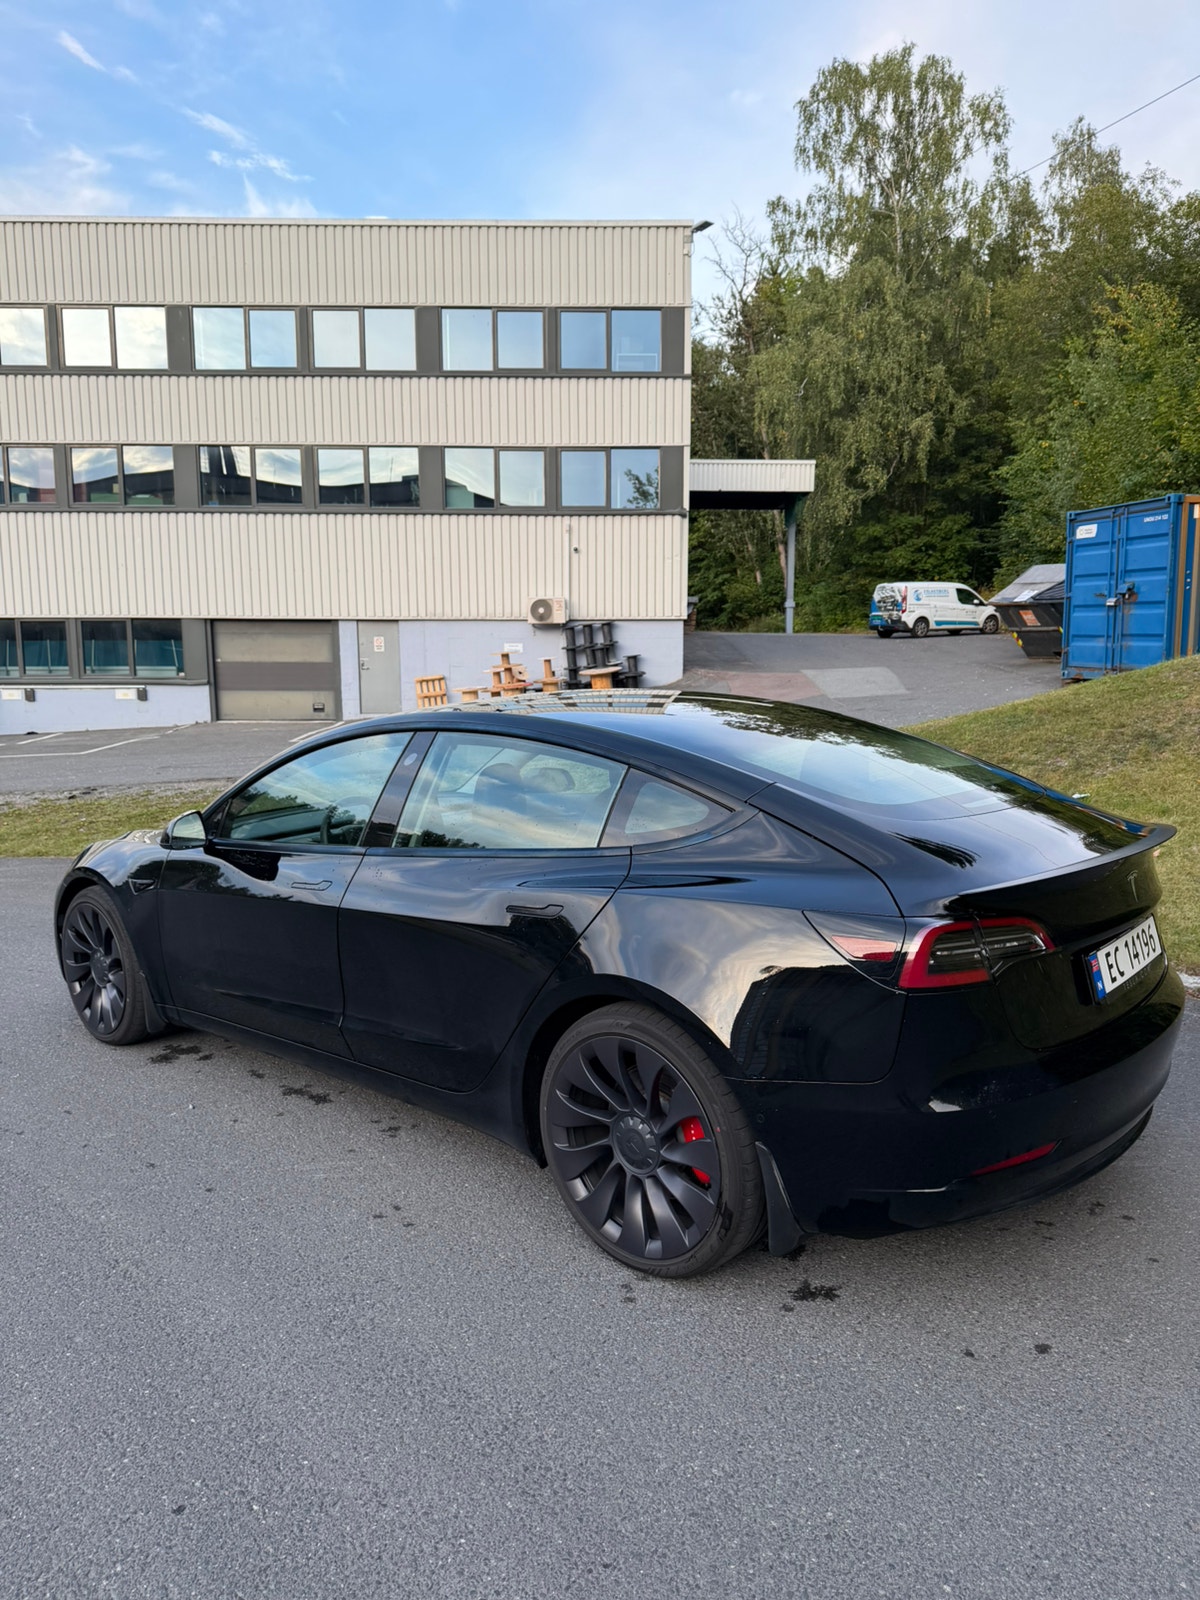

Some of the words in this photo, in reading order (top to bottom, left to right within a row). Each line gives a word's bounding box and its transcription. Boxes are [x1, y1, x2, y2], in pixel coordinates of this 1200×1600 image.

[1104, 946, 1126, 984] EC
[1124, 923, 1156, 970] 14196
[1096, 980, 1103, 991] N
